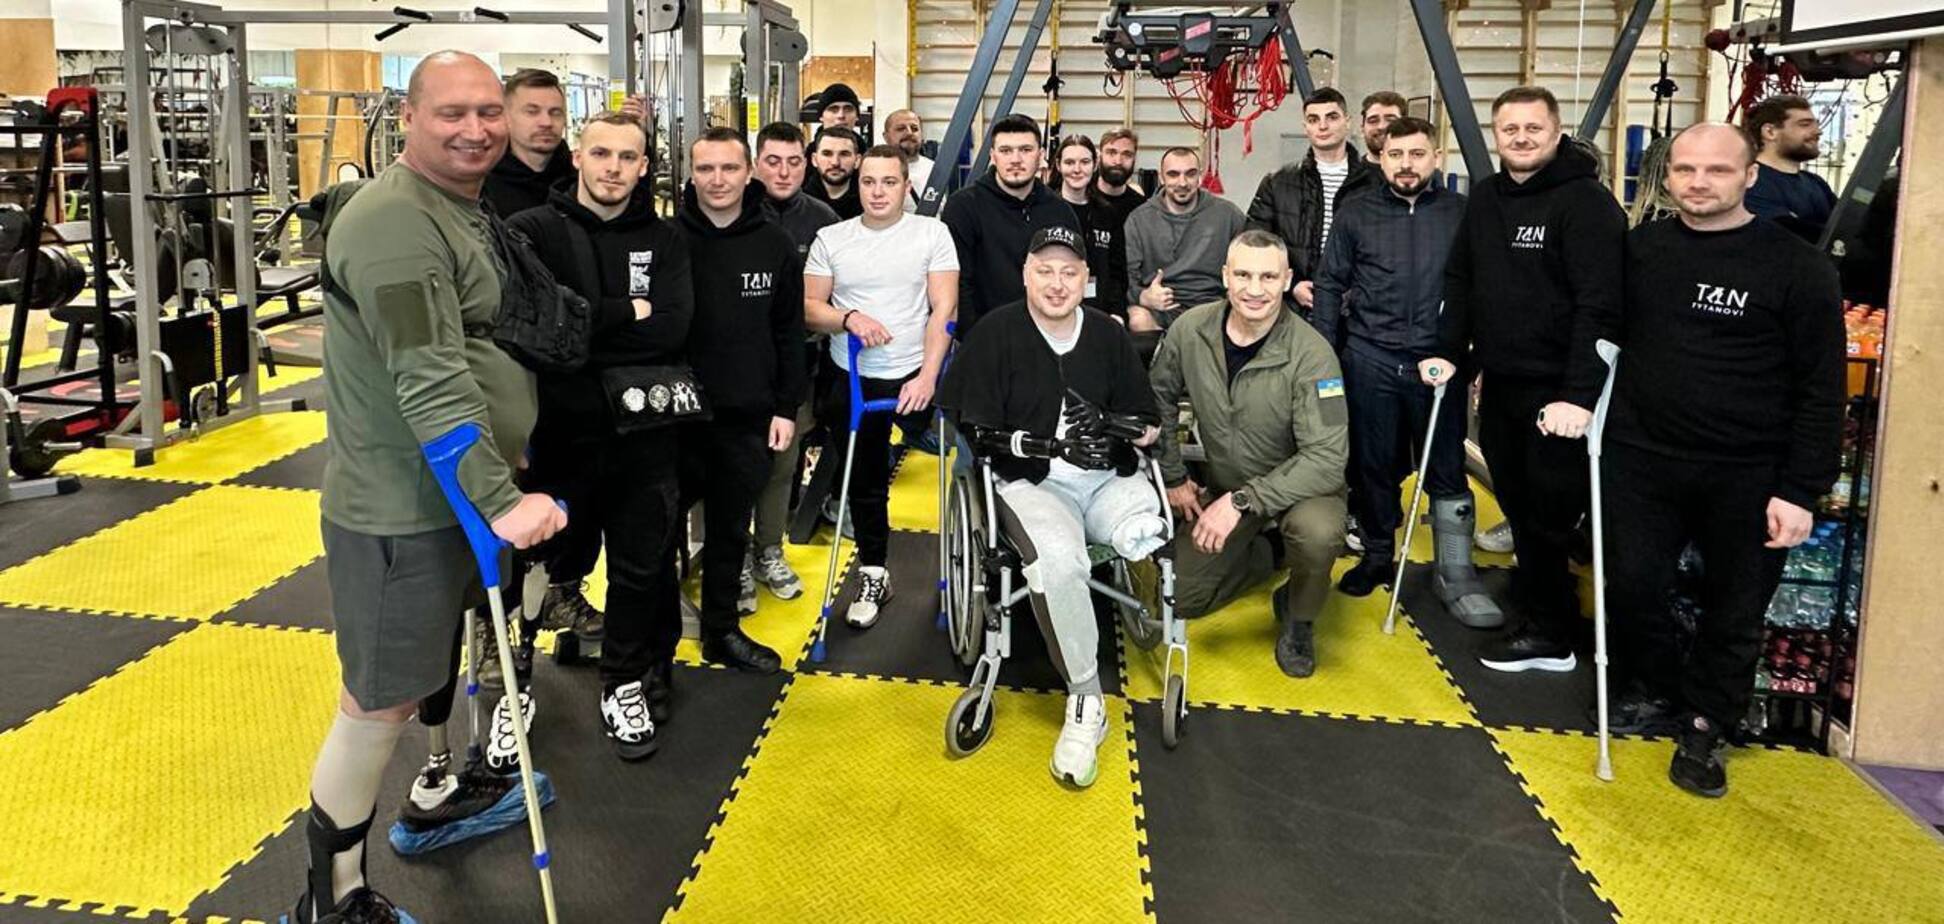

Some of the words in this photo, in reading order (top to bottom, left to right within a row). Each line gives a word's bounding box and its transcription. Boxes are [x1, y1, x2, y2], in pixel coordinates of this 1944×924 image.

[1045, 227, 1075, 241] TAN
[1515, 225, 1546, 241] TAN
[741, 272, 773, 289] TAN
[1696, 283, 1749, 308] TAN
[1691, 302, 1744, 316] TYTANOVI
